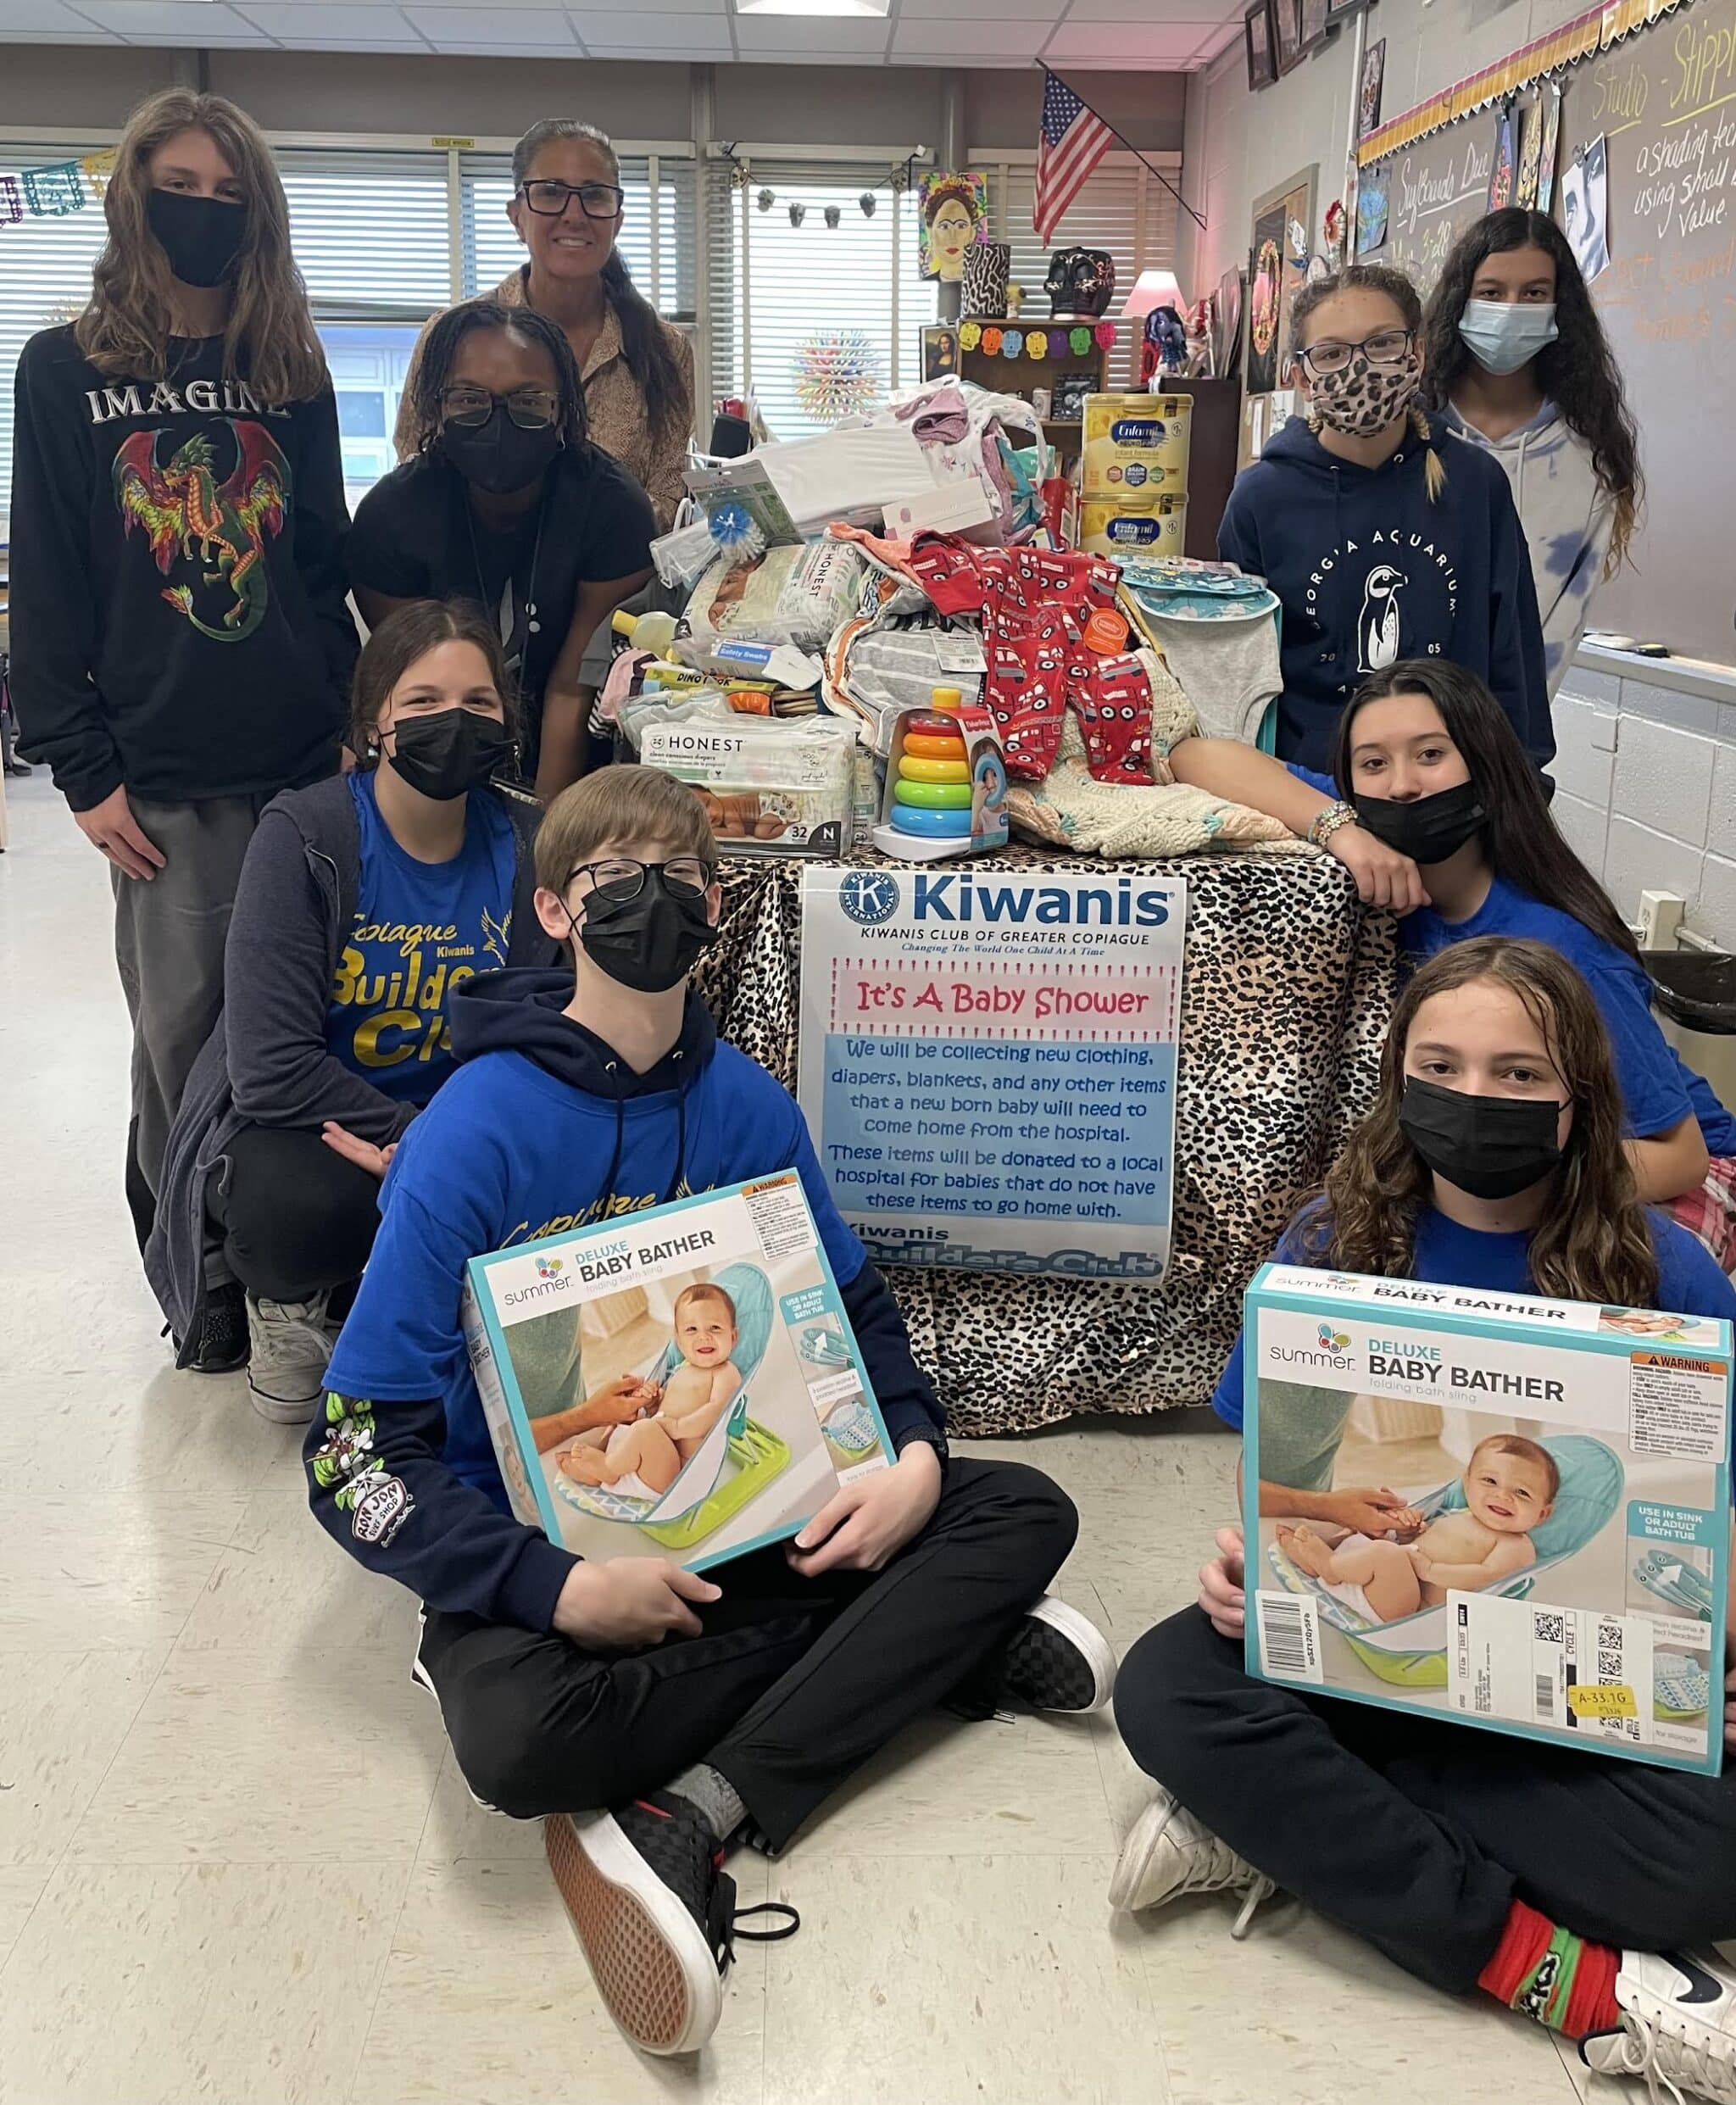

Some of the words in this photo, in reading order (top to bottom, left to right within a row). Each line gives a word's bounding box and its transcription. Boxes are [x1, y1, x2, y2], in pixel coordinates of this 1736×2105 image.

[809, 553, 835, 598] HONEST
[1428, 643, 1441, 654] 05
[677, 672, 701, 684] DINO
[670, 736, 743, 753] HONEST
[792, 826, 808, 838] 32
[823, 827, 835, 840] N
[914, 873, 1169, 927] Kiwanis
[861, 927, 924, 939] KIWANIS
[931, 929, 969, 940] CLUB
[976, 931, 995, 941] OF
[1001, 932, 1066, 943] GREATER
[1072, 933, 1149, 944] COPIAGUE
[437, 944, 475, 958] Kiwanis
[902, 943, 948, 954] Changing
[953, 944, 970, 952] The
[975, 944, 1002, 953] World
[1081, 947, 1104, 955] Time
[857, 982, 906, 1011] It's
[913, 983, 943, 1012] A
[951, 983, 1025, 1014] Baby
[1035, 987, 1149, 1019] Shower
[846, 1039, 875, 1058] We
[881, 1042, 909, 1058] will
[915, 1043, 937, 1058] be
[943, 1045, 1031, 1063] collecting
[1036, 1049, 1070, 1062] new
[1076, 1048, 1153, 1066] clothing,
[832, 1068, 901, 1087] diapers,
[907, 1072, 987, 1090] blankets,
[993, 1075, 1025, 1089] and
[1031, 1078, 1060, 1092] any
[1066, 1078, 1116, 1093] other
[1121, 1078, 1166, 1094] items
[850, 1094, 889, 1109] that
[894, 1098, 904, 1110] a
[910, 1098, 945, 1111] new
[951, 1096, 992, 1112] born
[999, 1099, 1038, 1116] baby
[1043, 1100, 1072, 1117] will
[1079, 1102, 1121, 1117] need
[1126, 1105, 1147, 1117] to
[865, 1119, 912, 1133] come
[918, 1120, 965, 1135] home
[970, 1122, 1013, 1138] from
[1018, 1123, 1049, 1139] the
[1055, 1124, 1130, 1142] hospital.
[828, 1144, 882, 1161] These
[888, 1146, 934, 1162] items
[940, 1149, 969, 1165] will
[975, 1150, 996, 1165] be
[1002, 1151, 1075, 1168] donated
[1080, 1156, 1101, 1168] to
[1106, 1158, 1116, 1171] a
[1122, 1156, 1163, 1172] local
[836, 1168, 904, 1186] hospital
[910, 1172, 939, 1187] for
[944, 1173, 999, 1189] babies
[1005, 1175, 1044, 1191] that
[1049, 1178, 1072, 1192] do
[1078, 1180, 1109, 1193] not
[1114, 1180, 1155, 1195] have
[865, 1194, 915, 1207] these
[921, 1195, 968, 1211] items
[971, 1200, 992, 1211] to
[997, 1200, 1019, 1214] go
[1025, 1200, 1071, 1215] home
[1077, 1202, 1121, 1218] with.
[576, 1240, 629, 1265] DELUXE
[580, 1253, 633, 1283] BABY
[640, 1230, 716, 1265] BATHER
[1373, 1288, 1448, 1303] BABY
[1454, 1298, 1567, 1320] BATHER
[1369, 1339, 1441, 1361] DELUXE
[1660, 1356, 1710, 1373] WARNING
[1369, 1356, 1443, 1383] BABY
[1450, 1367, 1564, 1402] BATHER
[1370, 1378, 1413, 1395] folding
[1416, 1382, 1444, 1398] bath
[1449, 1389, 1477, 1404] sling
[381, 1498, 398, 1520] SHOP
[1639, 1506, 1661, 1517] USE
[1663, 1510, 1674, 1519] IN
[1677, 1512, 1702, 1523] SINK
[357, 1506, 372, 1540] RON
[1645, 1517, 1661, 1526] OR
[1662, 1519, 1696, 1531] ADULT
[1645, 1526, 1672, 1537] BATH
[1674, 1530, 1695, 1540] TUB
[1566, 1631, 1575, 1655] CYCLE
